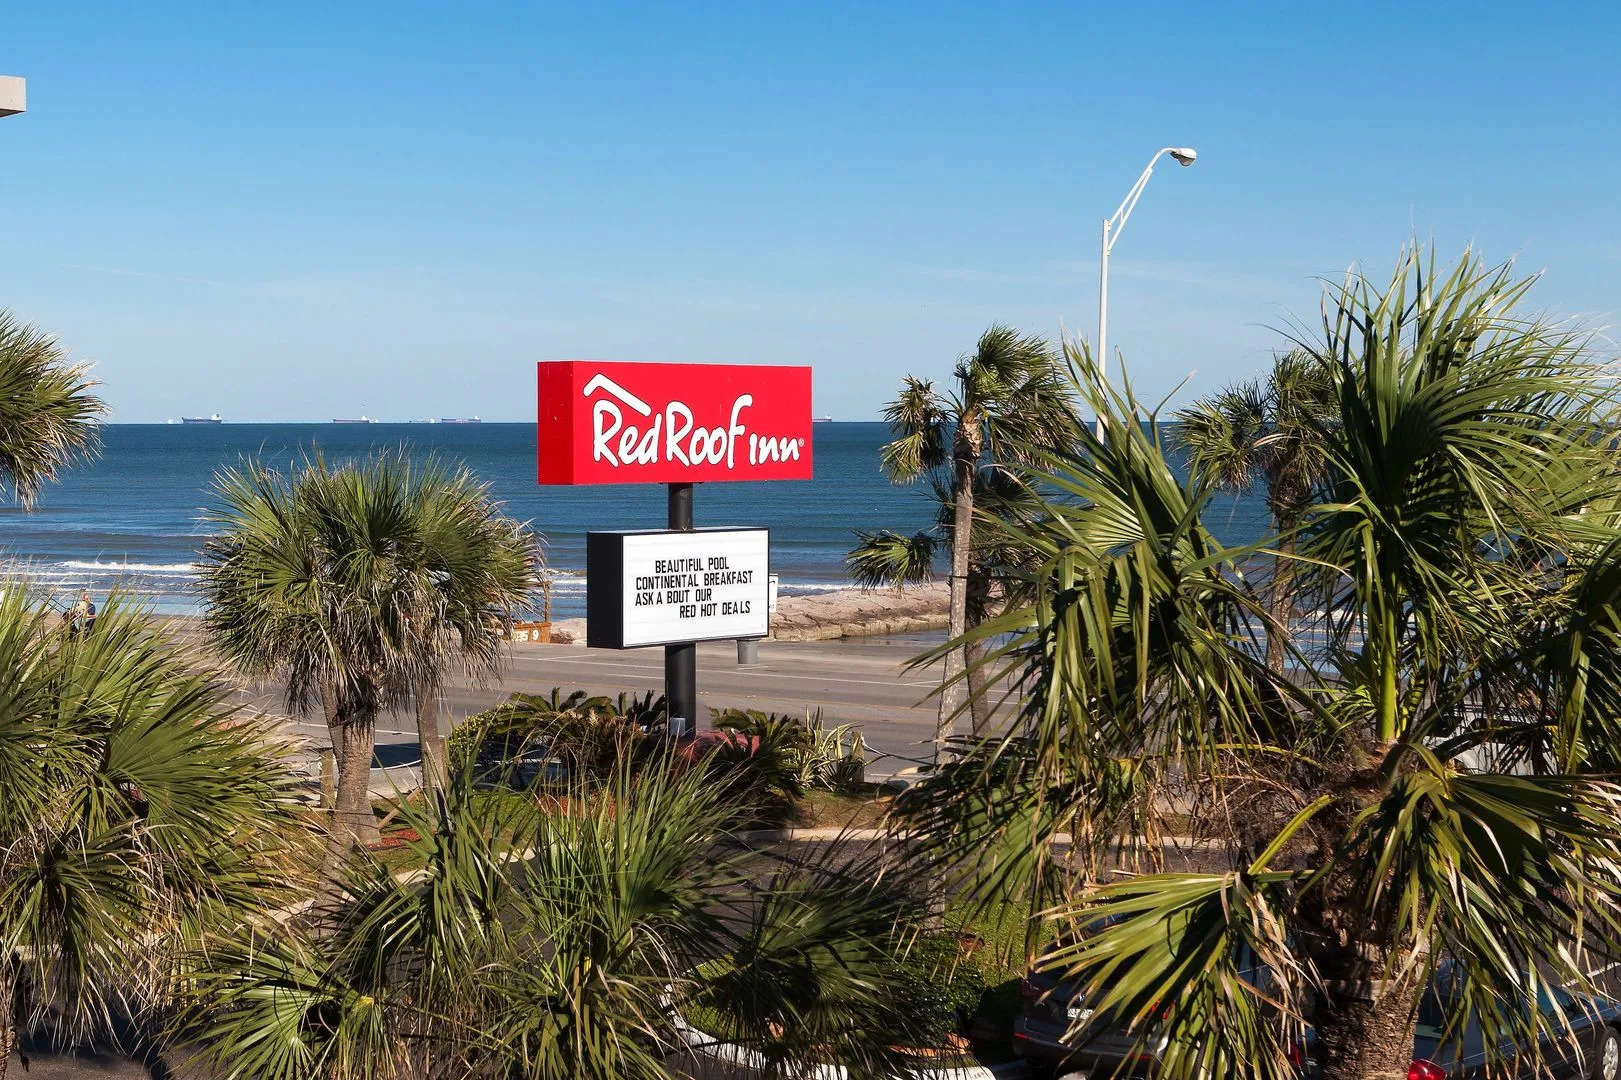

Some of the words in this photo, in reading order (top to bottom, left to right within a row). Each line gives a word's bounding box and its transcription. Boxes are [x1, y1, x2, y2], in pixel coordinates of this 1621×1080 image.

[593, 399, 663, 468] Red
[665, 393, 753, 470] Roof
[655, 558, 704, 574] BEAUTIFUL
[708, 556, 730, 571] POOL
[636, 573, 699, 591] CONTINENTAL
[703, 570, 754, 587] BREAKFAST
[635, 591, 654, 606] ASK
[695, 588, 712, 602] OUR
[679, 604, 697, 619] RED
[700, 602, 718, 617] HOT
